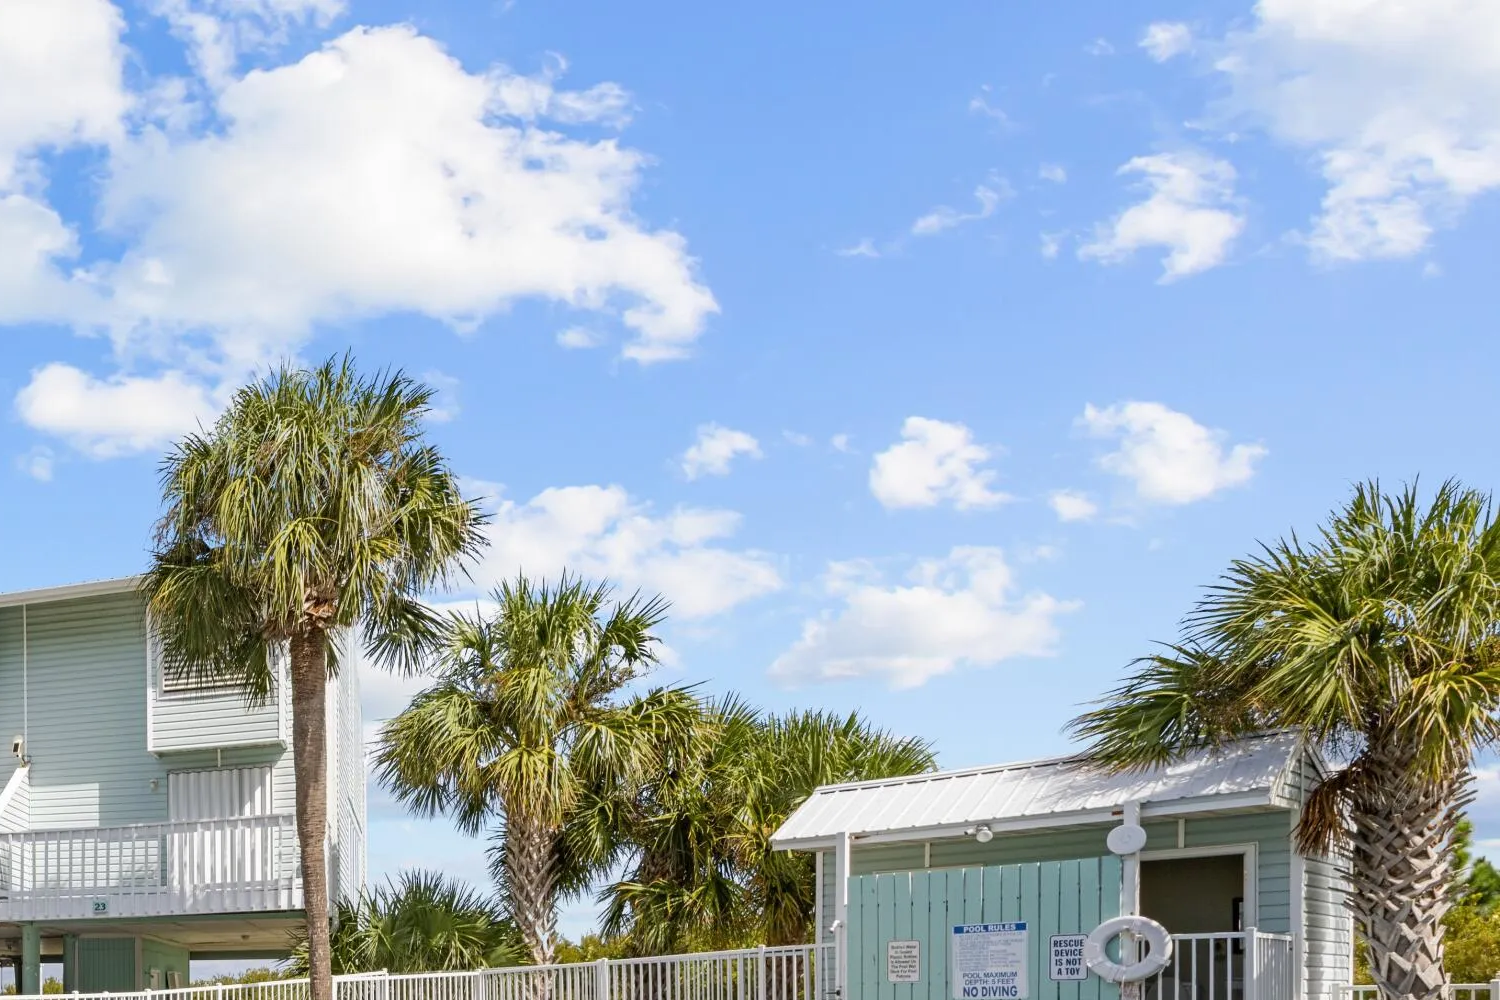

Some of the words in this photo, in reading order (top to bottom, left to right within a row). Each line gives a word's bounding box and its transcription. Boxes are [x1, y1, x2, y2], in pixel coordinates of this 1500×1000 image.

[94, 902, 106, 910] 23
[963, 925, 986, 933] POOL
[988, 924, 1016, 932] RULES
[1054, 939, 1084, 948] RESCUE
[1054, 948, 1084, 956] DEVICE
[1066, 958, 1082, 966] NOT
[963, 986, 978, 997] NO
[982, 985, 1018, 997] DIVING
